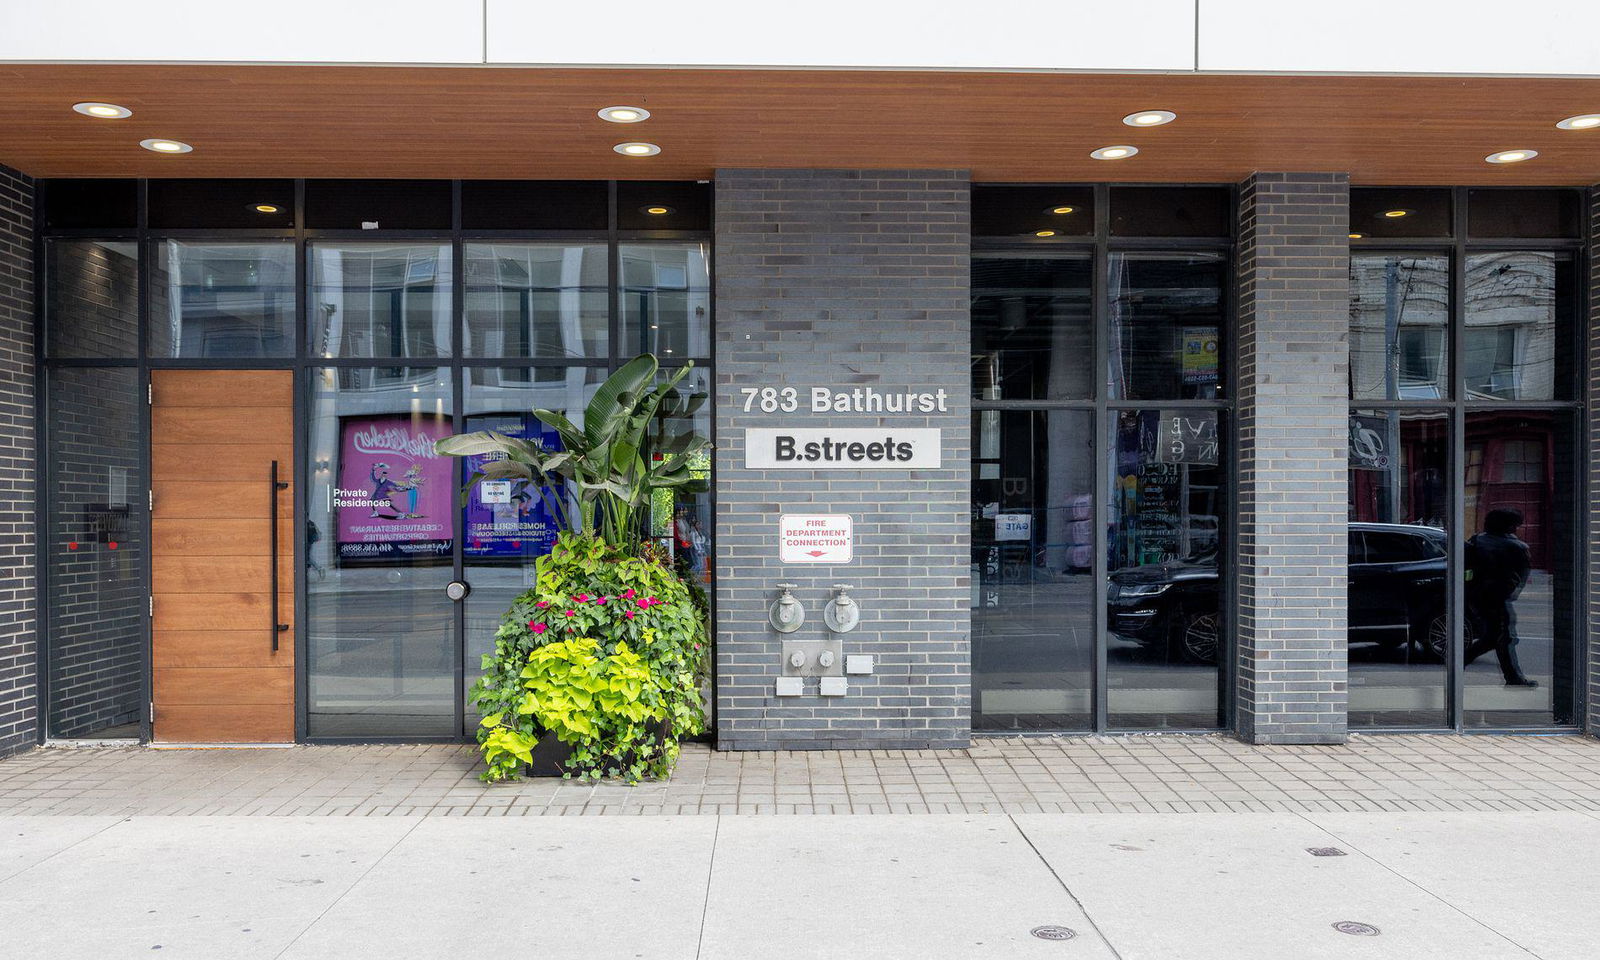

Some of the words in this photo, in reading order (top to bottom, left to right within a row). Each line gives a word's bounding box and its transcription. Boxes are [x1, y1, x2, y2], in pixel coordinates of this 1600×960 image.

[741, 387, 799, 414] 783
[811, 387, 948, 414] Bathurst
[775, 435, 914, 462] B.streets
[333, 488, 368, 497] Private
[333, 498, 391, 507] Residences
[786, 529, 847, 537] DEPARTMENT
[786, 539, 847, 547] CONNECTION
